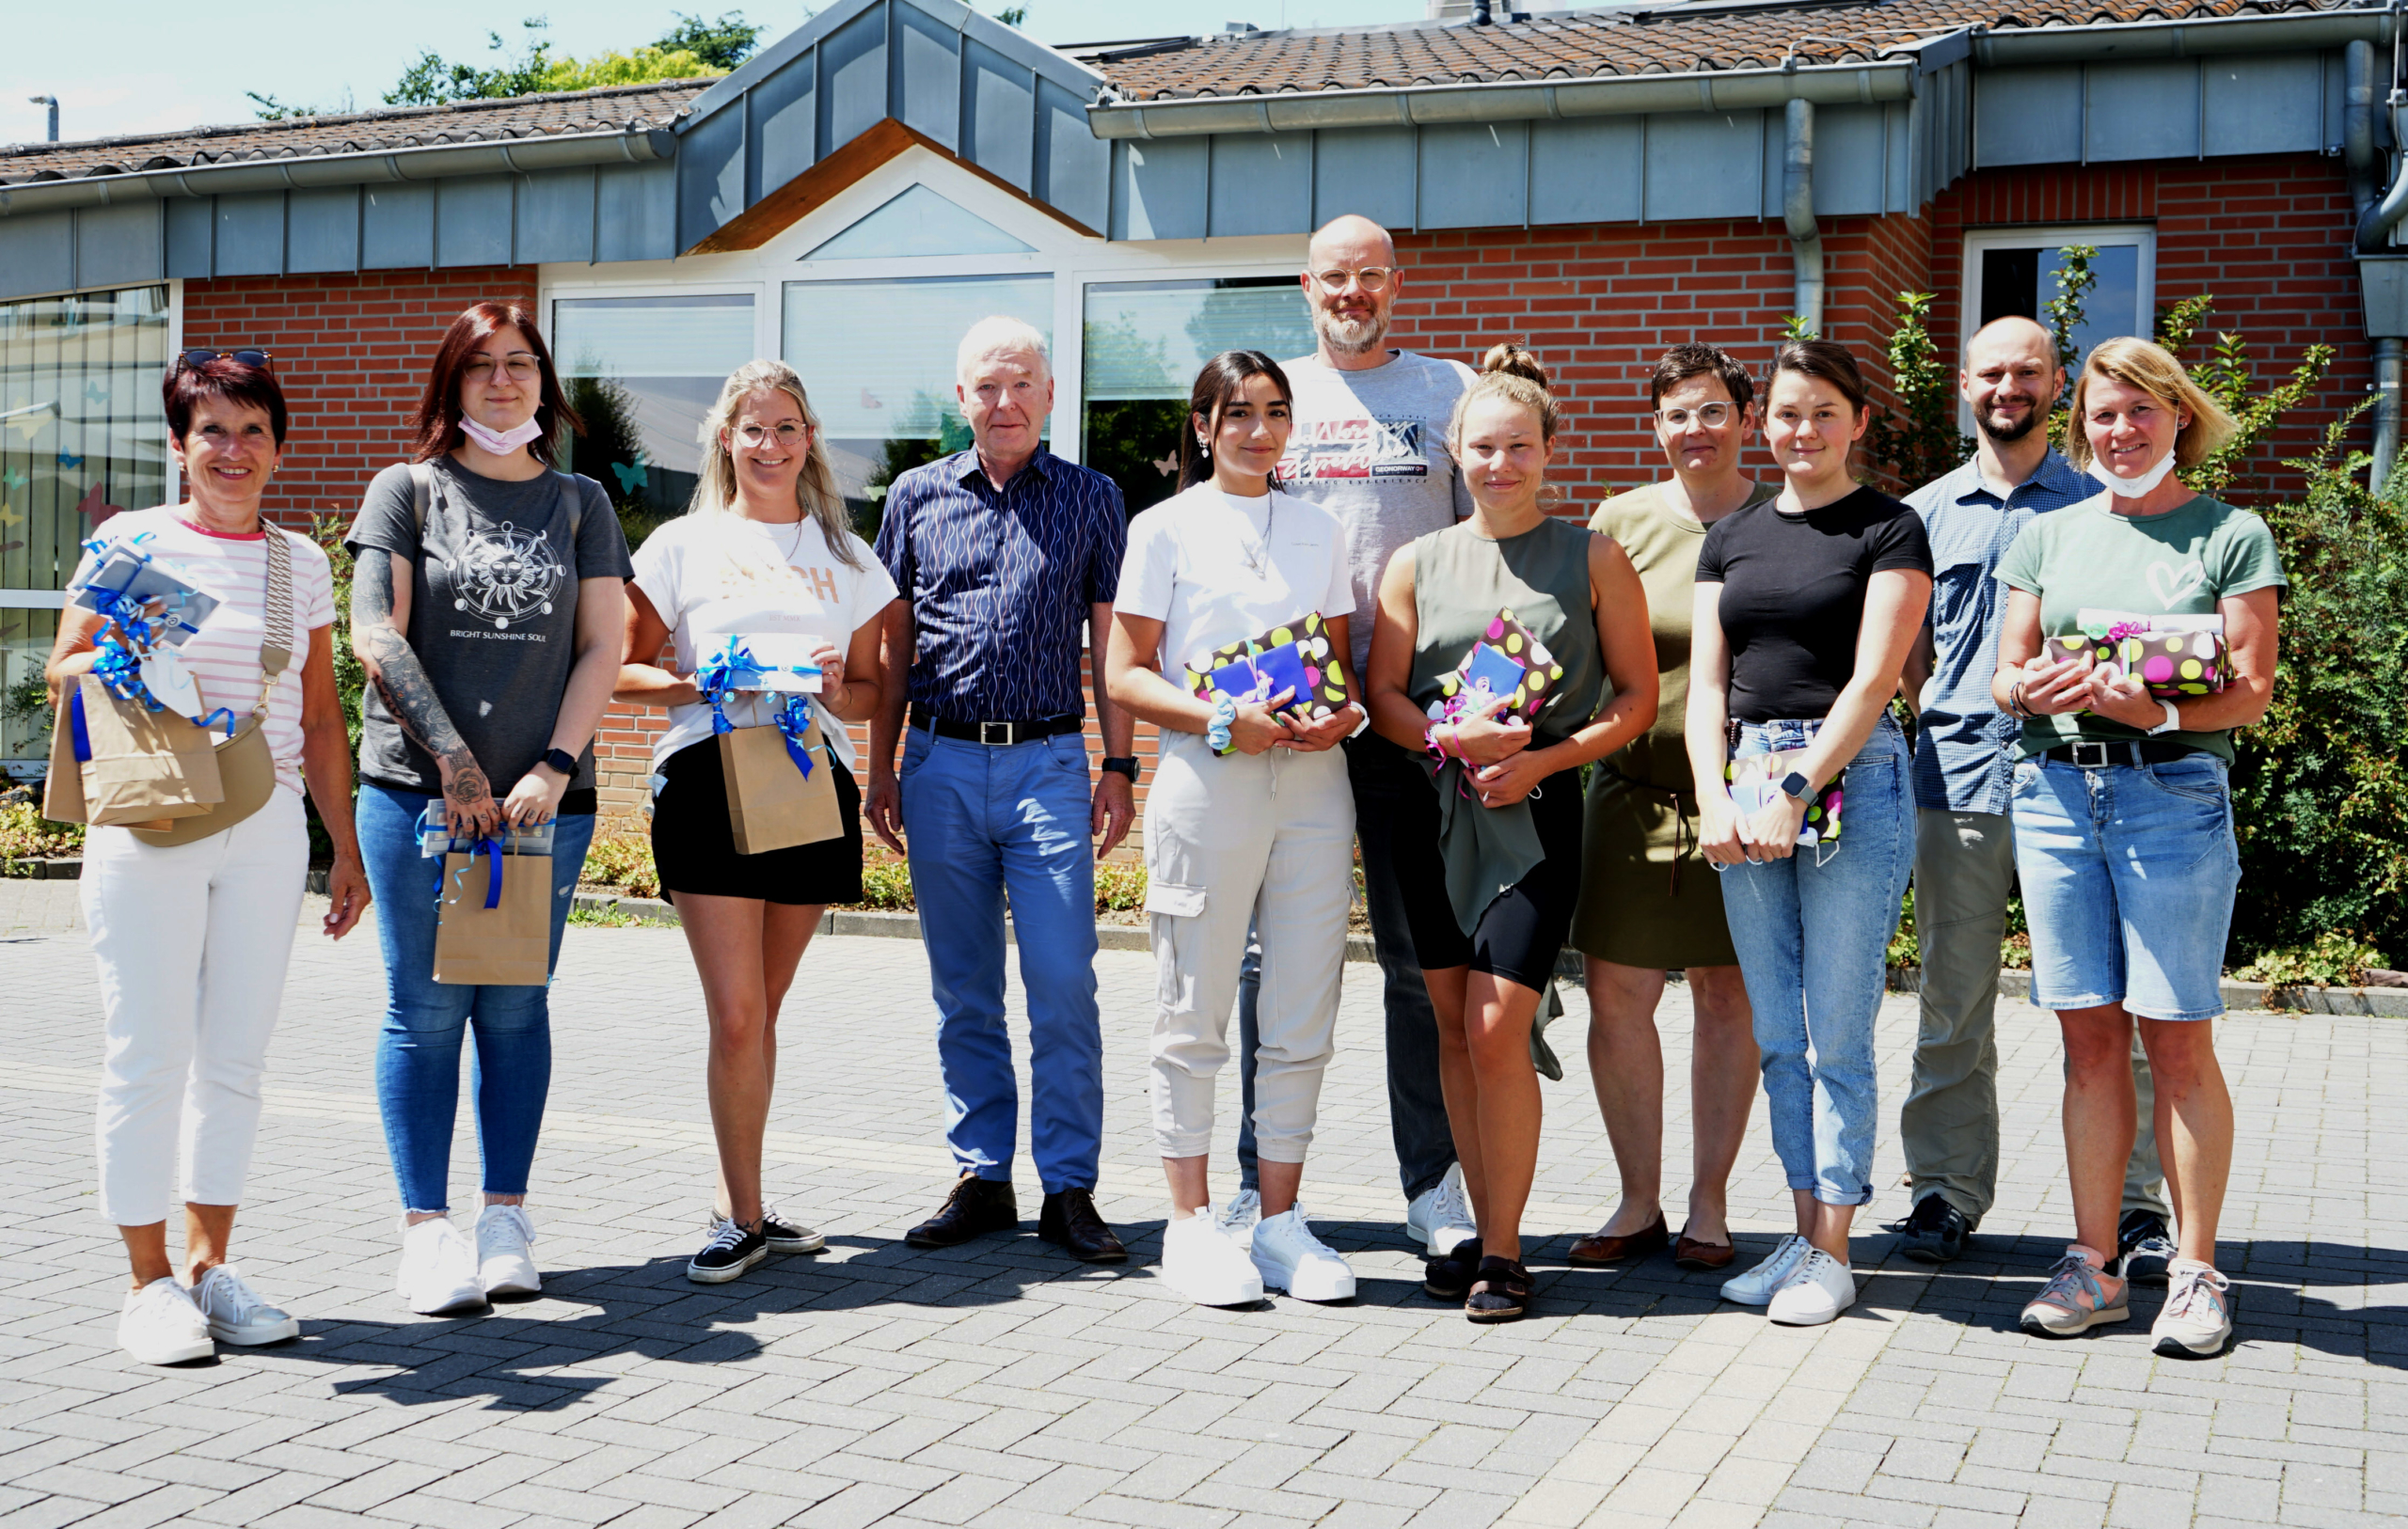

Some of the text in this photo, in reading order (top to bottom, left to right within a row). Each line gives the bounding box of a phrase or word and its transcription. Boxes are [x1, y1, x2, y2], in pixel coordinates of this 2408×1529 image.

[1313, 419, 1416, 444] Noray
[450, 629, 547, 643] BRIGHT SUNSHINE SOUL
